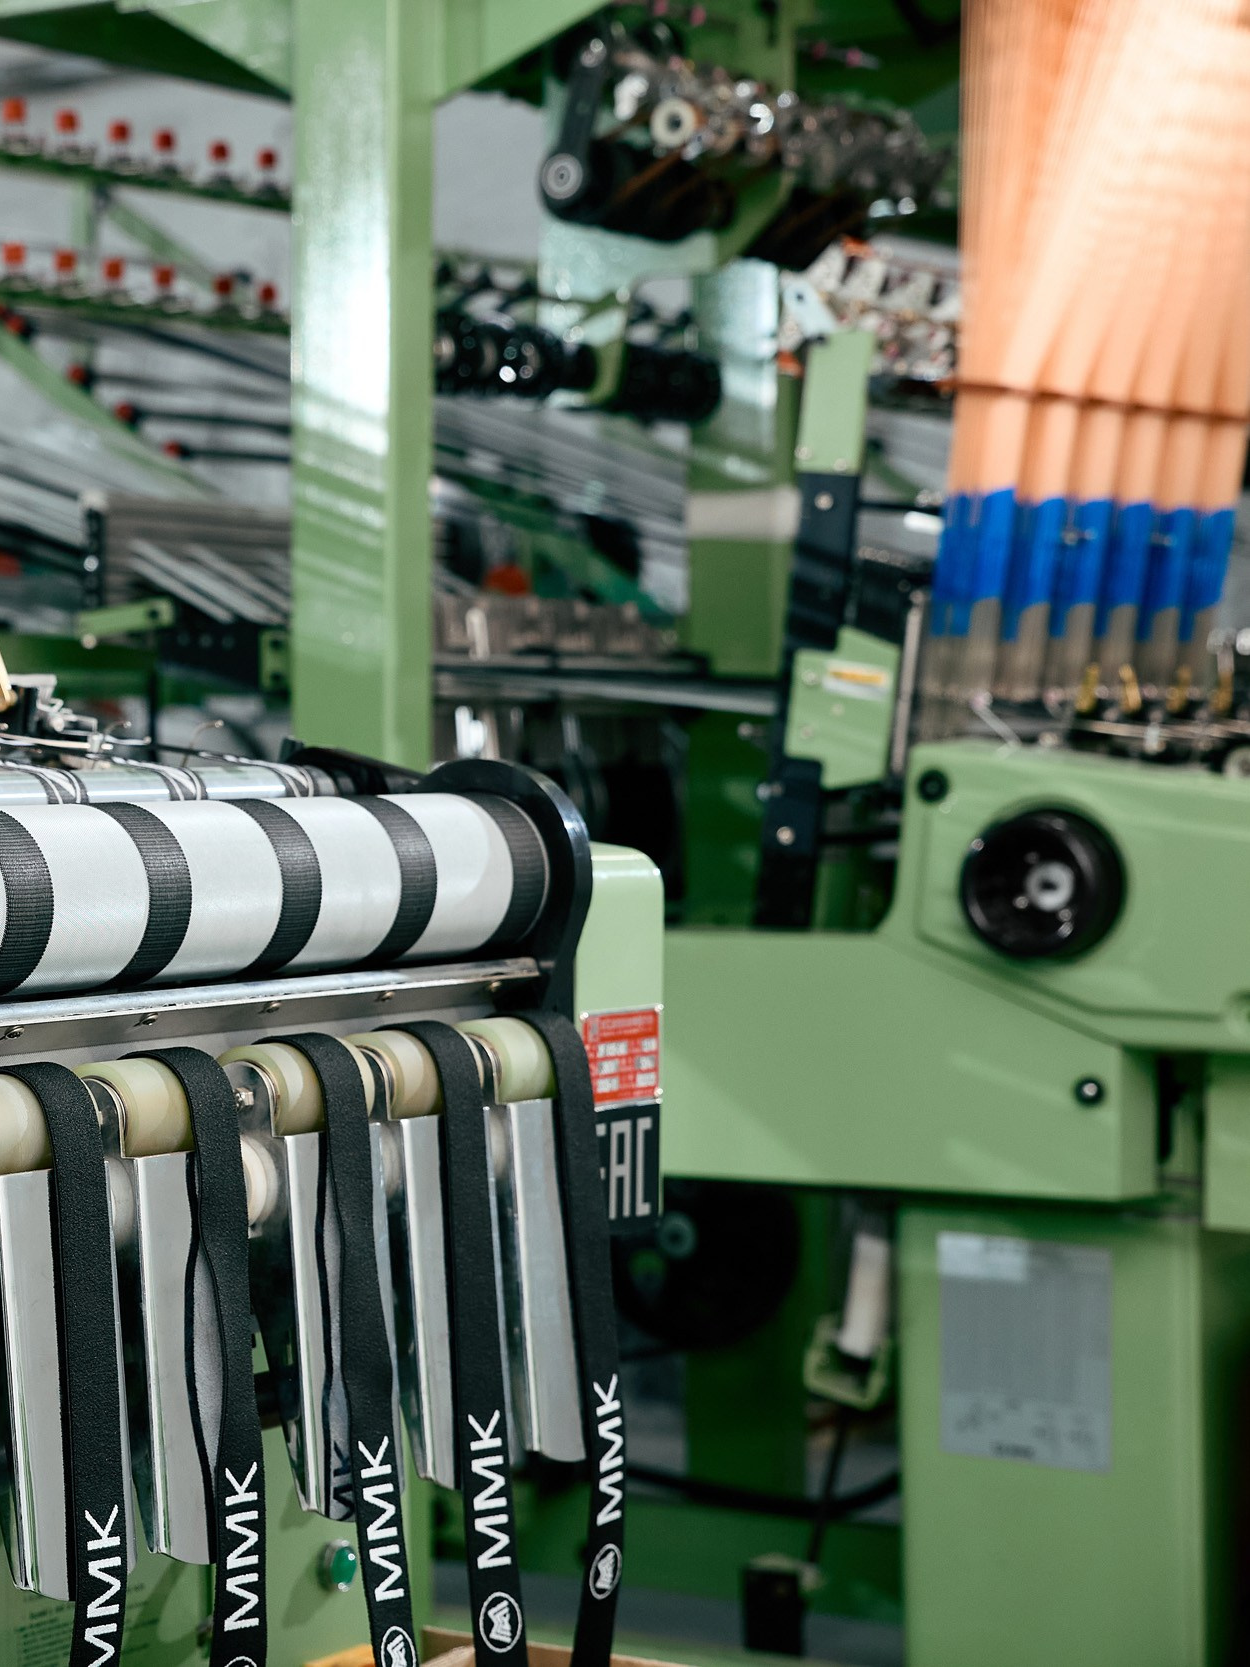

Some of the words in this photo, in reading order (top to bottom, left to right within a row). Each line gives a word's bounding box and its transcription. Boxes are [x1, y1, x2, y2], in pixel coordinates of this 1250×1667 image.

[595, 1116, 652, 1220] AC
[357, 1435, 405, 1602] MMK
[467, 1409, 512, 1570] MMK
[592, 1373, 625, 1527] MMK
[84, 1504, 122, 1667] MMK
[224, 1461, 260, 1632] MMK
